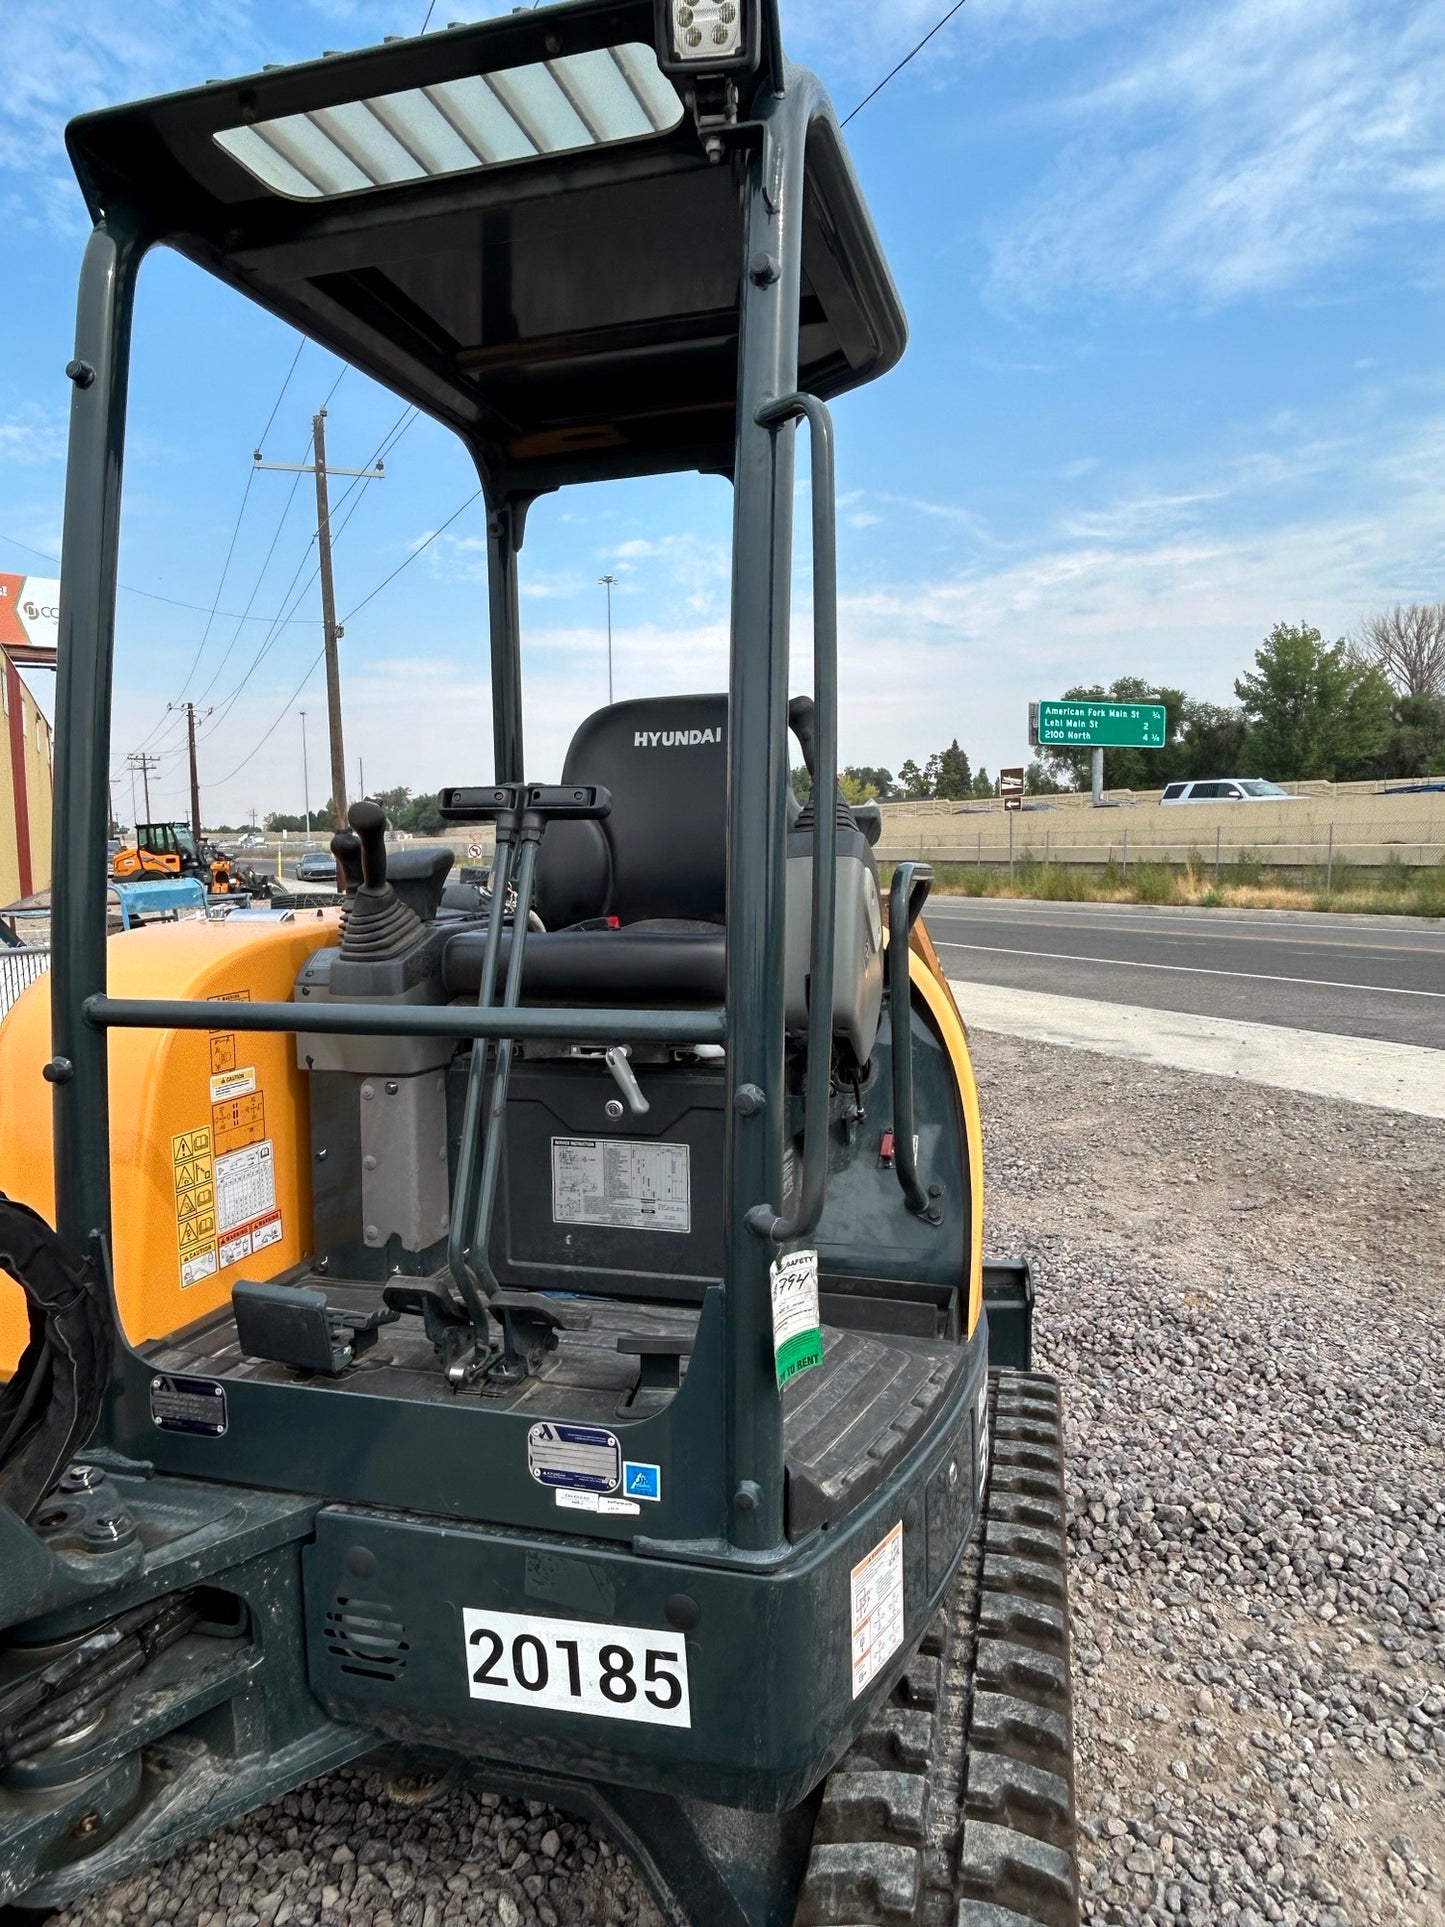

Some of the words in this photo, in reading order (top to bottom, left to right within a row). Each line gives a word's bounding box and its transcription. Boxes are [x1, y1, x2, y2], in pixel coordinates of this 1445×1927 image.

[1045, 707, 1084, 716] American
[1088, 708, 1105, 717] Fork
[1109, 709, 1128, 718] Main
[1131, 710, 1140, 718] St
[1044, 719, 1063, 727] Lehi
[1066, 720, 1086, 728] Main
[1089, 720, 1099, 728] St
[1143, 722, 1149, 730] 2
[634, 727, 722, 747] HYUNDAI
[1044, 730, 1064, 739] 2100
[1067, 731, 1091, 740] North
[796, 1353, 820, 1370] RENT
[469, 1628, 682, 1710] 20185
